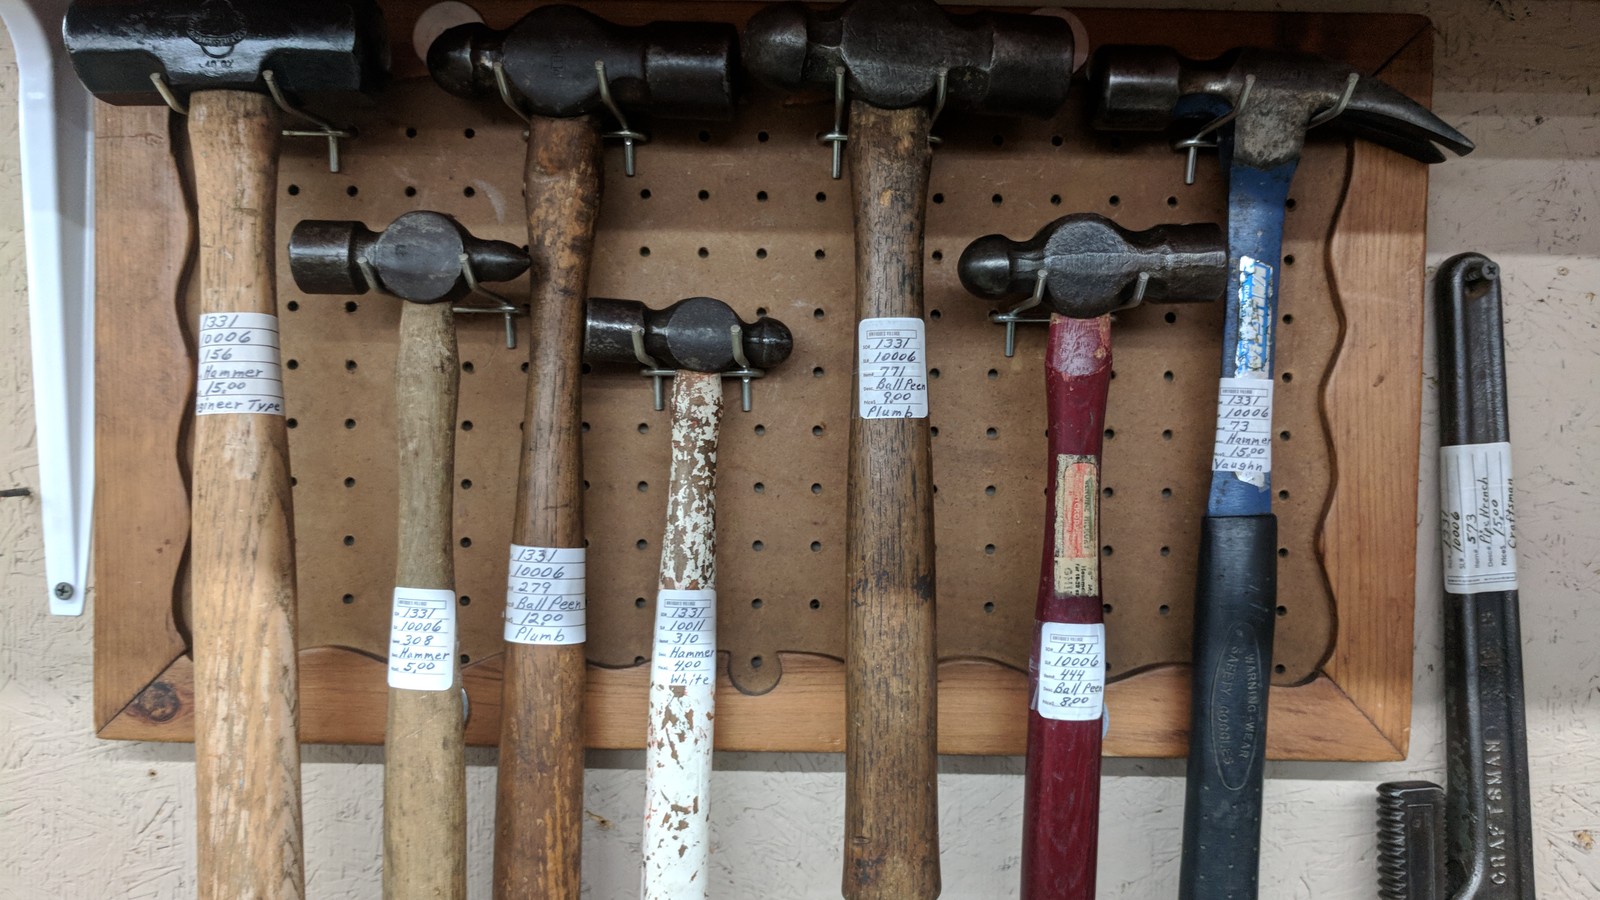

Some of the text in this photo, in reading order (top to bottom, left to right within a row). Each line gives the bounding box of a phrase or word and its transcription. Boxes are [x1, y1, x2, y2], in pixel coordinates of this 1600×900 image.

[203, 314, 239, 329] 1331
[875, 337, 911, 349] 1331
[204, 347, 233, 361] 156
[873, 350, 916, 363] 10006
[204, 364, 264, 379] Hammer
[879, 365, 906, 377] 771
[876, 377, 904, 391] Ball
[903, 378, 926, 391] Peen
[247, 399, 281, 412] Type
[1228, 395, 1260, 406] 1331
[867, 405, 913, 418] Plumb
[1225, 407, 1269, 419] 10006
[1230, 420, 1250, 432] 73
[1226, 431, 1271, 445] Hammer
[1214, 458, 1263, 472] Vaughn
[1505, 478, 1517, 549] Craftsman
[1450, 511, 1463, 553] 10006
[1465, 513, 1478, 545] 573
[517, 549, 558, 563] 1331
[514, 564, 565, 579] 10006
[518, 581, 552, 594] 279
[516, 595, 581, 611] Ball Peen
[403, 607, 436, 619] 1331
[671, 607, 705, 618] 1331
[400, 620, 443, 632] 10006
[669, 619, 706, 631] 10011
[402, 634, 434, 646] 308
[515, 626, 565, 642] Plumb
[672, 632, 699, 645] 310
[399, 647, 450, 661] Hammer
[669, 646, 715, 658] Hammer
[1058, 643, 1094, 654] 1331
[1054, 654, 1099, 668] 10006
[670, 673, 710, 686] White
[1060, 668, 1086, 681] 444
[1053, 681, 1082, 696] Ball
[1238, 653, 1258, 759] WARNING WEAR
[1484, 740, 1507, 886] CRAFTSMAN
